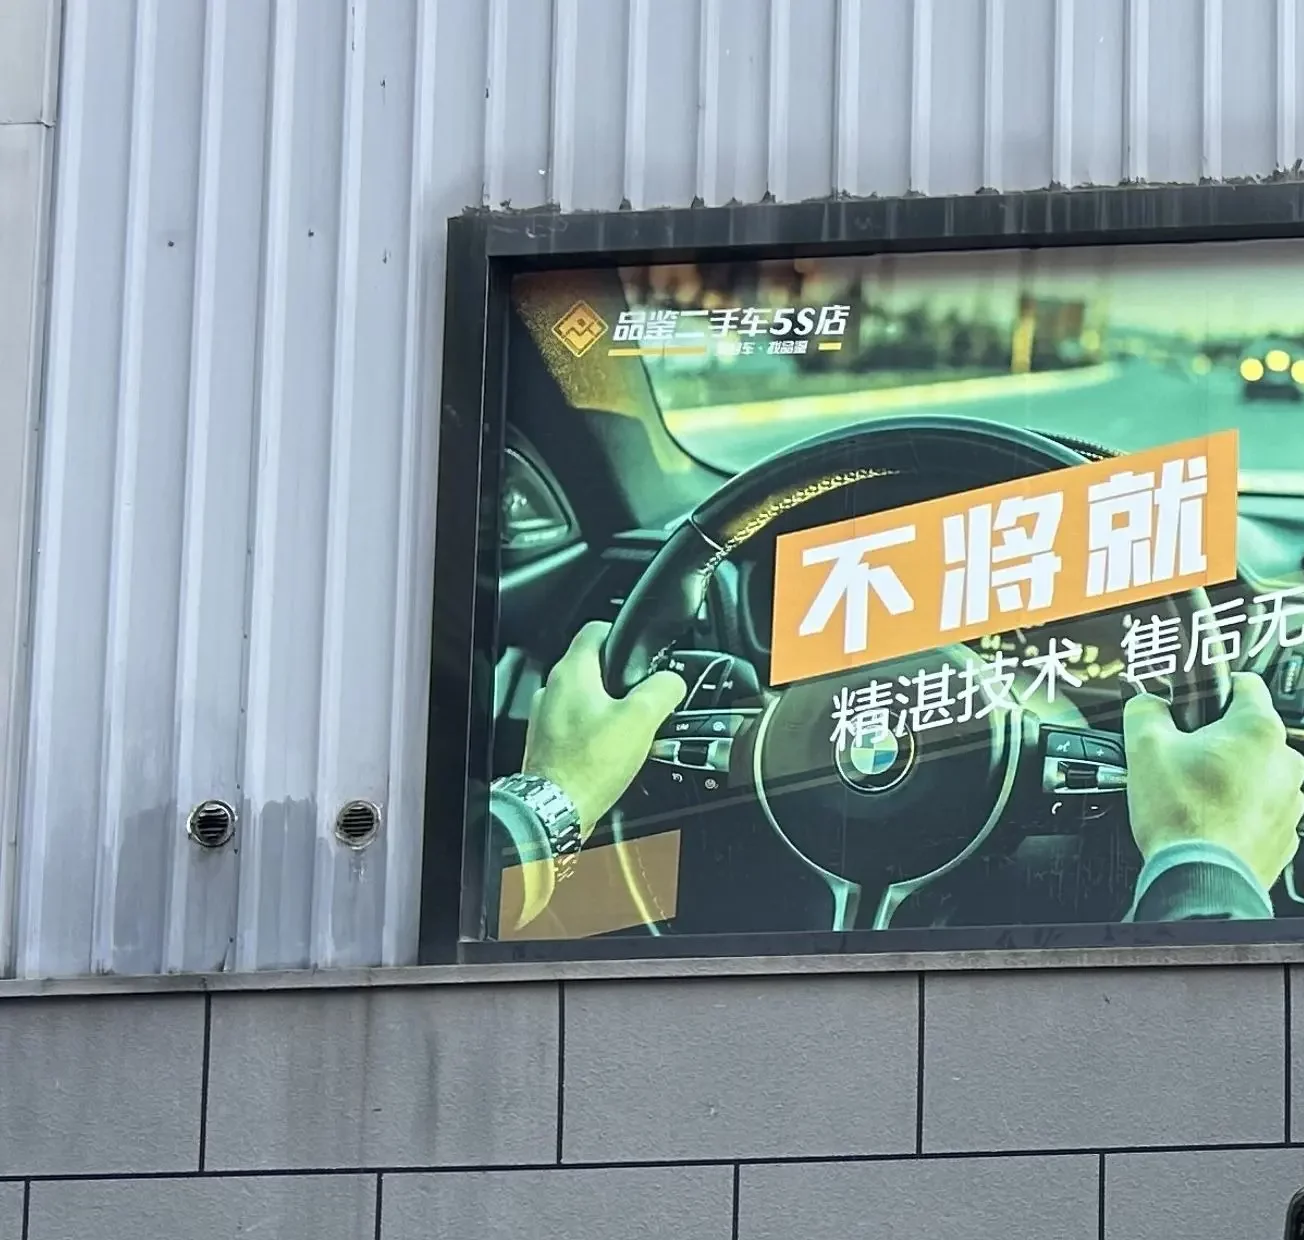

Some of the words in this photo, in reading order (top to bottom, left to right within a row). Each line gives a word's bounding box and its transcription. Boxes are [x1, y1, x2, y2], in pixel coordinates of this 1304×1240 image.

[613, 305, 850, 341] 品鉴二手车5S店
[799, 457, 1208, 654] 不将就
[828, 637, 1084, 753] 精湛技术
